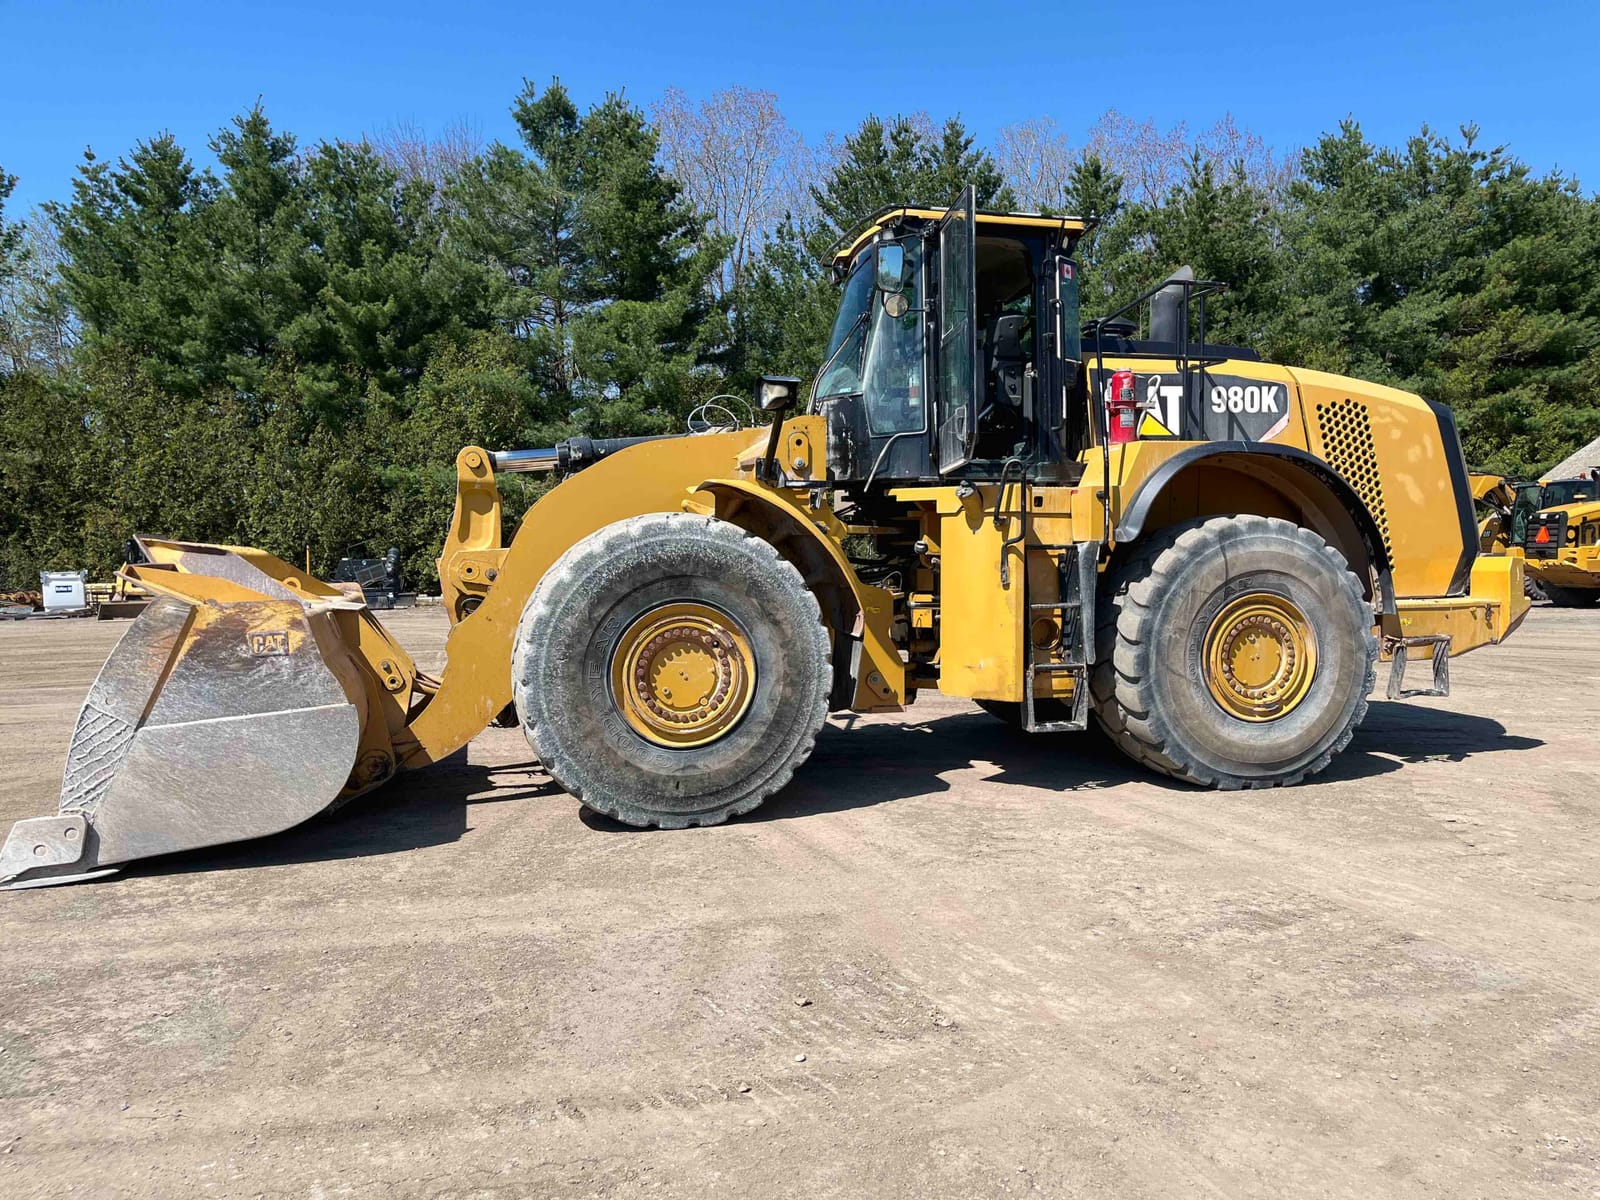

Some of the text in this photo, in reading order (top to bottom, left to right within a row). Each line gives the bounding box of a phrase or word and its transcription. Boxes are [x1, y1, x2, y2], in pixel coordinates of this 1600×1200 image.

[1146, 386, 1183, 436] AT
[1211, 385, 1279, 413] 980K
[1565, 516, 1600, 548] gh
[252, 634, 286, 654] CAT
